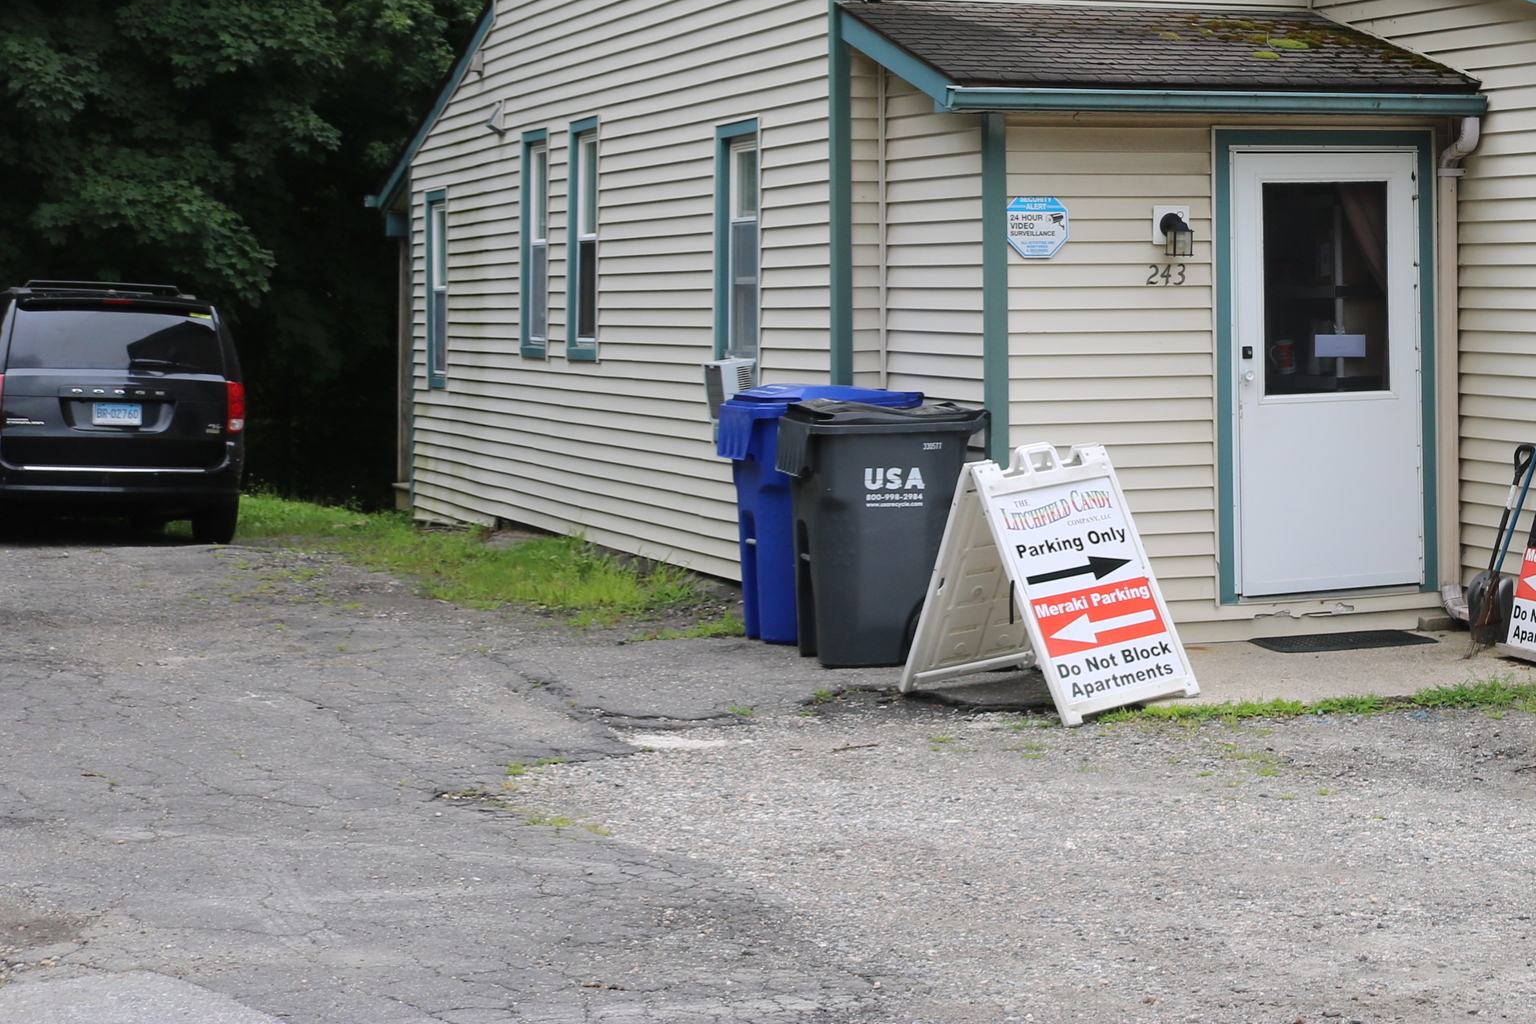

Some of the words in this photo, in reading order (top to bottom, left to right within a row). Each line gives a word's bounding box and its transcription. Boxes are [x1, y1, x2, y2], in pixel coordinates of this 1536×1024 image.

[1010, 222, 1035, 230] VIDEO
[1146, 263, 1187, 286] 243
[864, 467, 926, 491] USA
[865, 493, 924, 501] 800-998-2984
[1013, 499, 1030, 508] THE
[999, 498, 1072, 530] LITCHFIELD
[1070, 489, 1113, 513] CANDY
[1067, 516, 1101, 527] COMPANY,
[1016, 537, 1085, 559] Parking
[1087, 527, 1126, 545] Only
[1034, 595, 1089, 619] Meraki
[1089, 585, 1151, 607] Parking
[1513, 604, 1528, 621] Do
[1057, 663, 1082, 679] Do
[1084, 653, 1119, 673] Not
[1120, 641, 1172, 664] Block
[1071, 662, 1174, 698] Apartments
